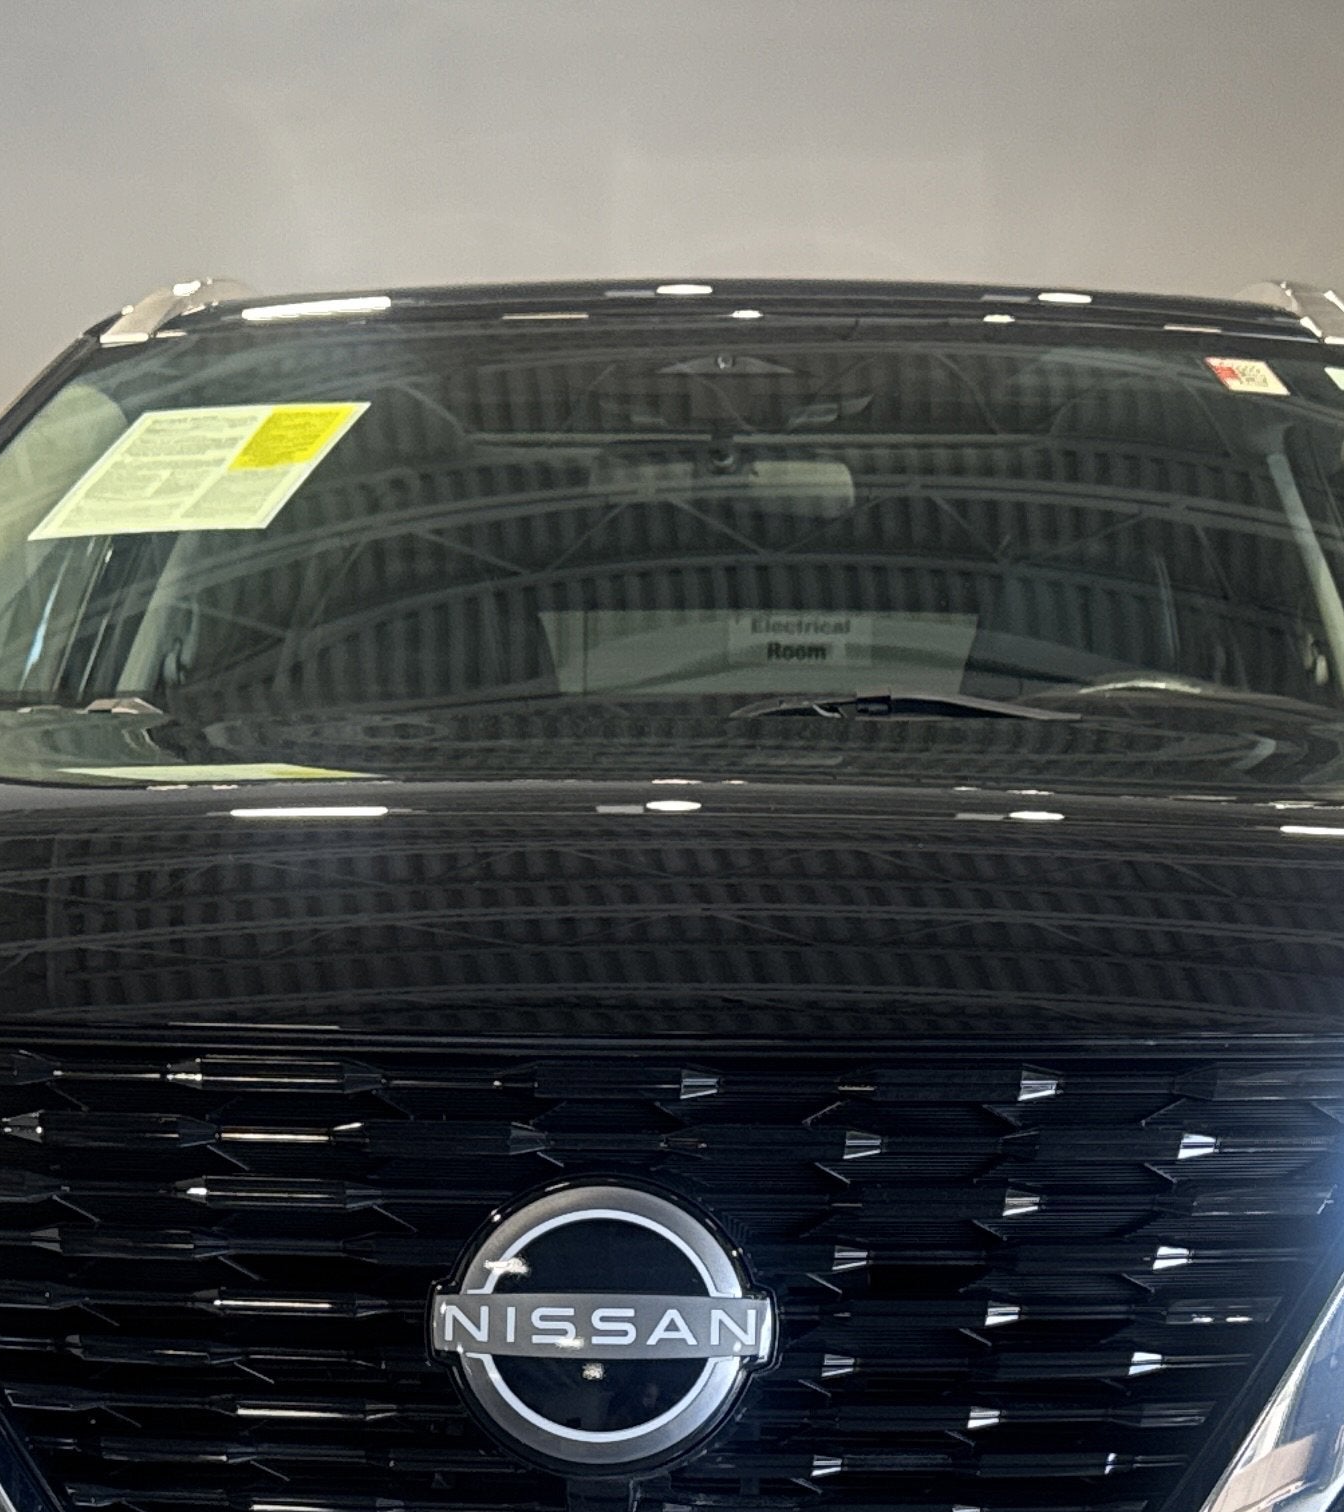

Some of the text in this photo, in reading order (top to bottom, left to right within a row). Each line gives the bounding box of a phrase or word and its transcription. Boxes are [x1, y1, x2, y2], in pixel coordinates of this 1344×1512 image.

[751, 617, 851, 635] Electrical
[767, 642, 827, 661] Room
[443, 1304, 757, 1346] NISSAN
